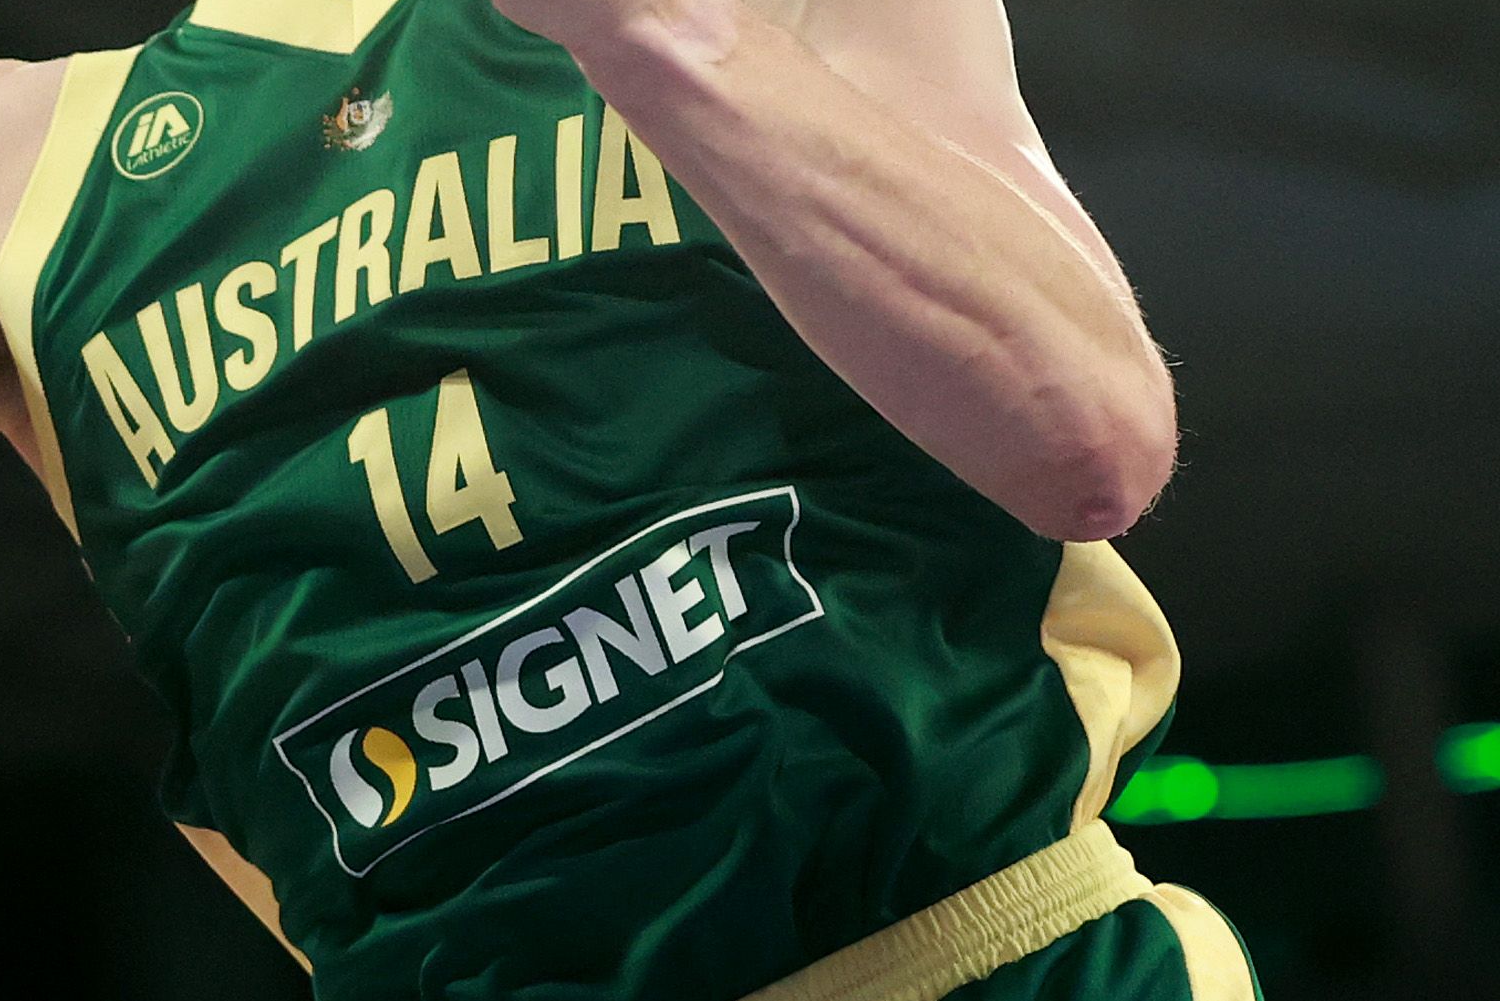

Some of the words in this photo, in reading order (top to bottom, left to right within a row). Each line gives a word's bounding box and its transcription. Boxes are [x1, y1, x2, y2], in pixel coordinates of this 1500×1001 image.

[81, 102, 681, 490] AUSTRALIA
[348, 369, 523, 584] 14
[412, 521, 761, 791] SIGNET
